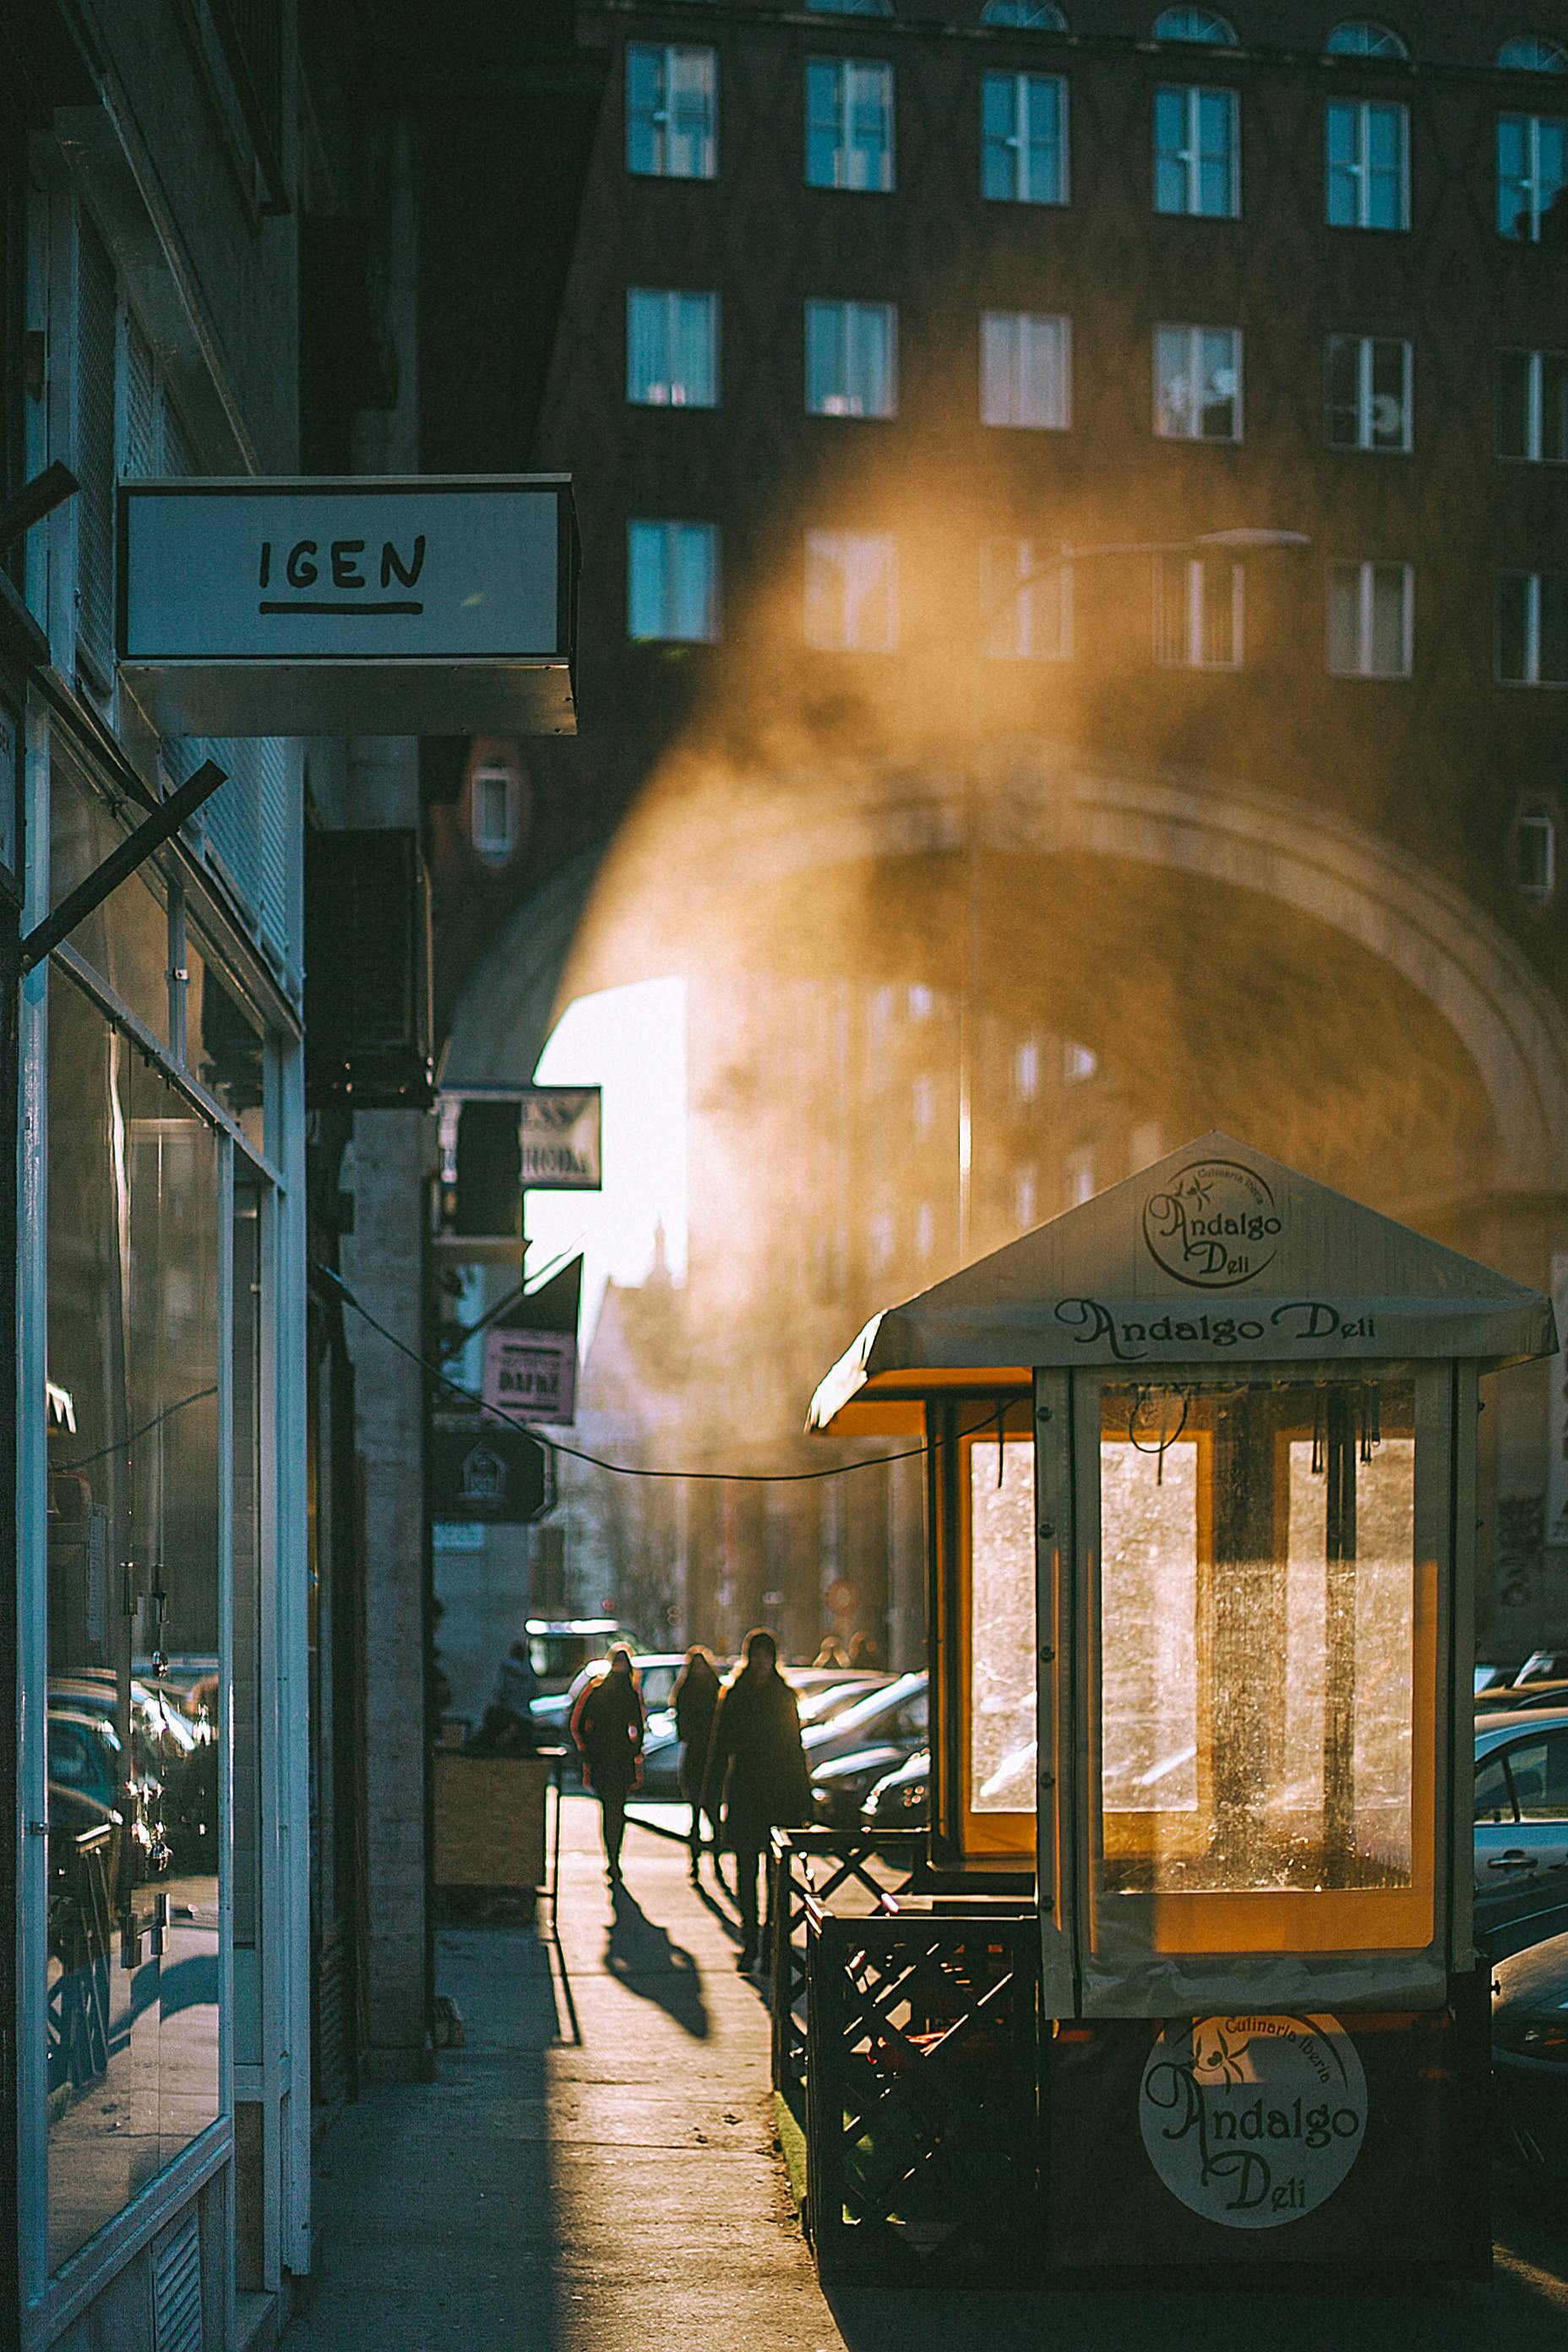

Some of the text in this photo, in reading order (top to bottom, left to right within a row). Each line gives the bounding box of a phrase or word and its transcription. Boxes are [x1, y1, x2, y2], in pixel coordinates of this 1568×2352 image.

[259, 535, 426, 589] IGEN
[1149, 1193, 1282, 1260] Andalgo
[1185, 1241, 1250, 1274] Deli
[1054, 1298, 1376, 1360] Andalgo Deli
[1226, 2017, 1331, 2084] Culinaria Iberia
[1146, 2061, 1360, 2186] Andalgo
[1206, 2149, 1307, 2212] Deli
